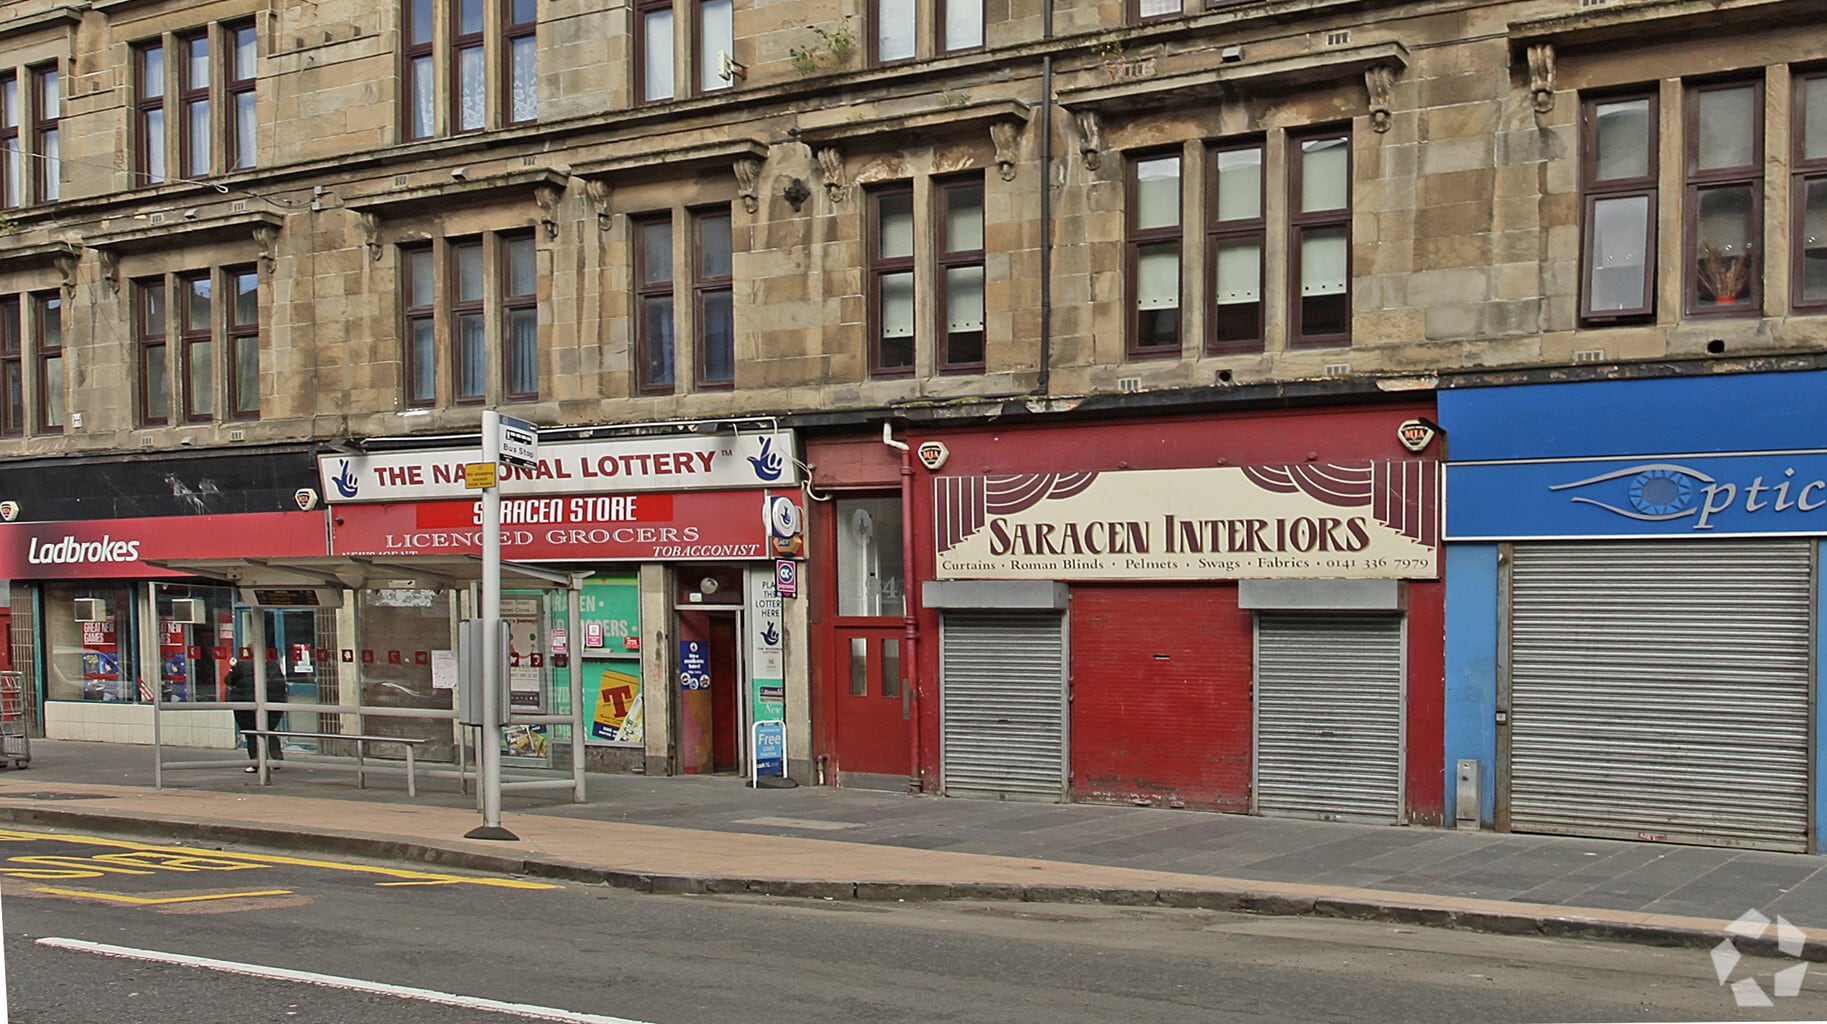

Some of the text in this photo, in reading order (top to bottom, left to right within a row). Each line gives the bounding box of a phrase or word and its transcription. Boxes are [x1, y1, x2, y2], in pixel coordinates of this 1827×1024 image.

[503, 443, 534, 459] Bus Stop
[374, 465, 424, 486] THE
[433, 458, 571, 484] NAONAL
[581, 450, 716, 477] LOTTERY
[473, 495, 637, 524] SRACEN STORE
[545, 527, 700, 544] GROCERS
[989, 514, 1371, 556] SARACEN INTERIORS
[28, 534, 140, 564] Ladbrokes
[652, 544, 760, 557] TOBACCONIST
[942, 556, 1429, 572] Curtains Roman Blinds Pelmets Swags Fabrics 0141 336 7979
[762, 581, 775, 589] PLA
[756, 600, 782, 608] LOTTER
[83, 622, 101, 633] GREAT
[83, 633, 104, 643] GAMES
[758, 733, 781, 745] Free
